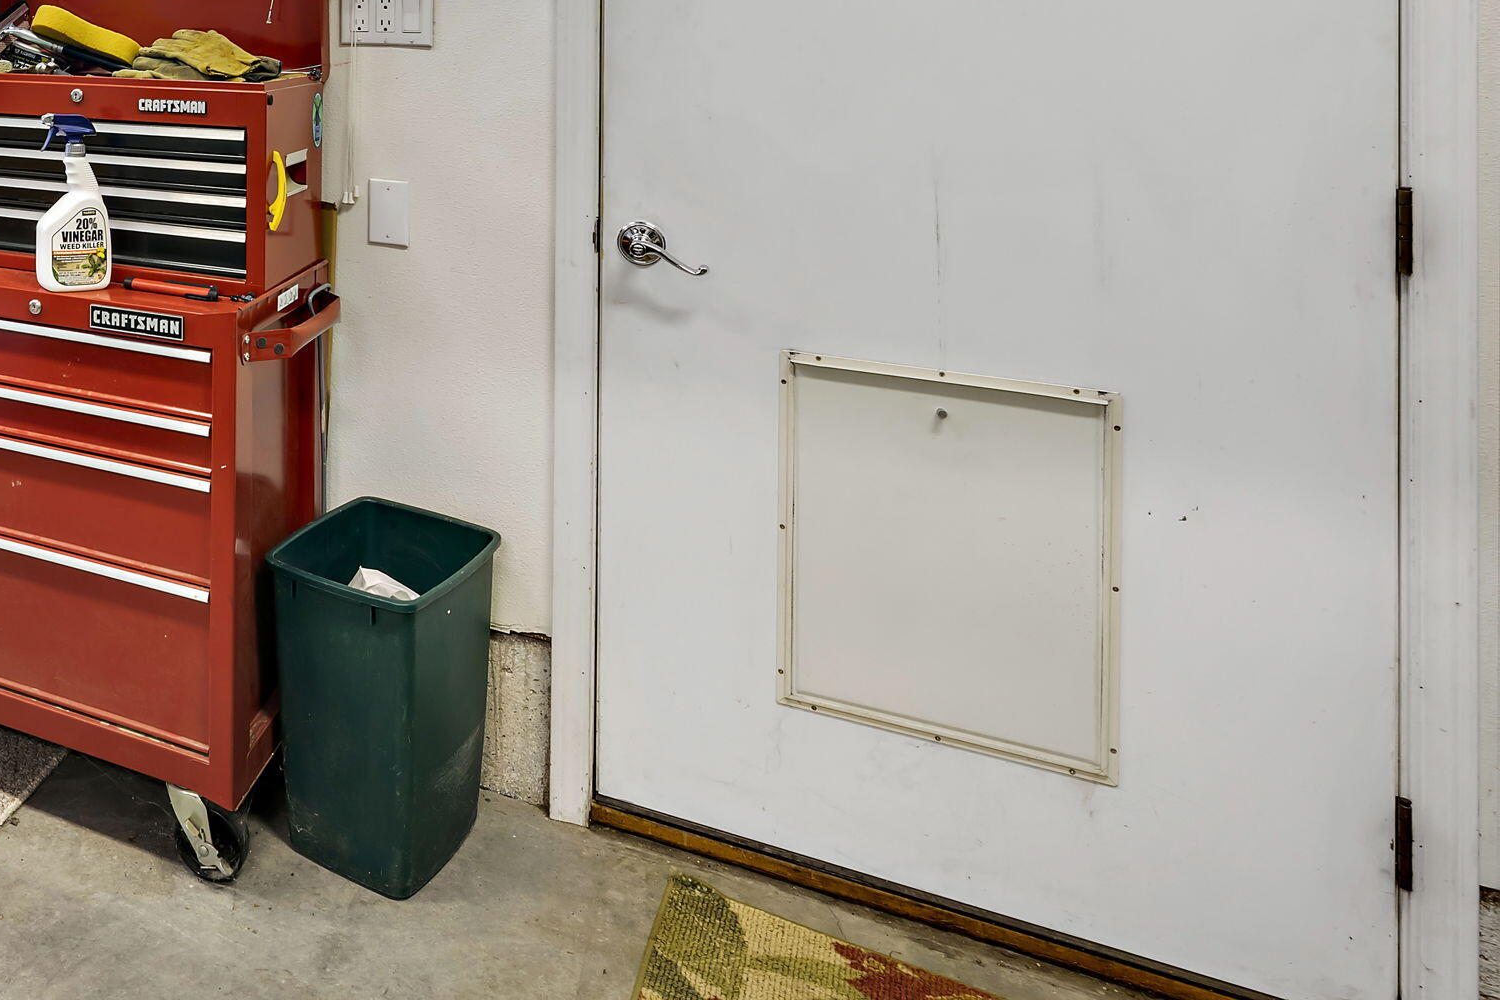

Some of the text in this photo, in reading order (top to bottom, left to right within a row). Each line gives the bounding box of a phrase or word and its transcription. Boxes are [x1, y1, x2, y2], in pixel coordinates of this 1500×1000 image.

[138, 98, 206, 114] CRAFTSMAN
[76, 218, 97, 230] 20%
[61, 230, 103, 242] VINEGAR
[93, 309, 180, 335] CRAFTSMAN
